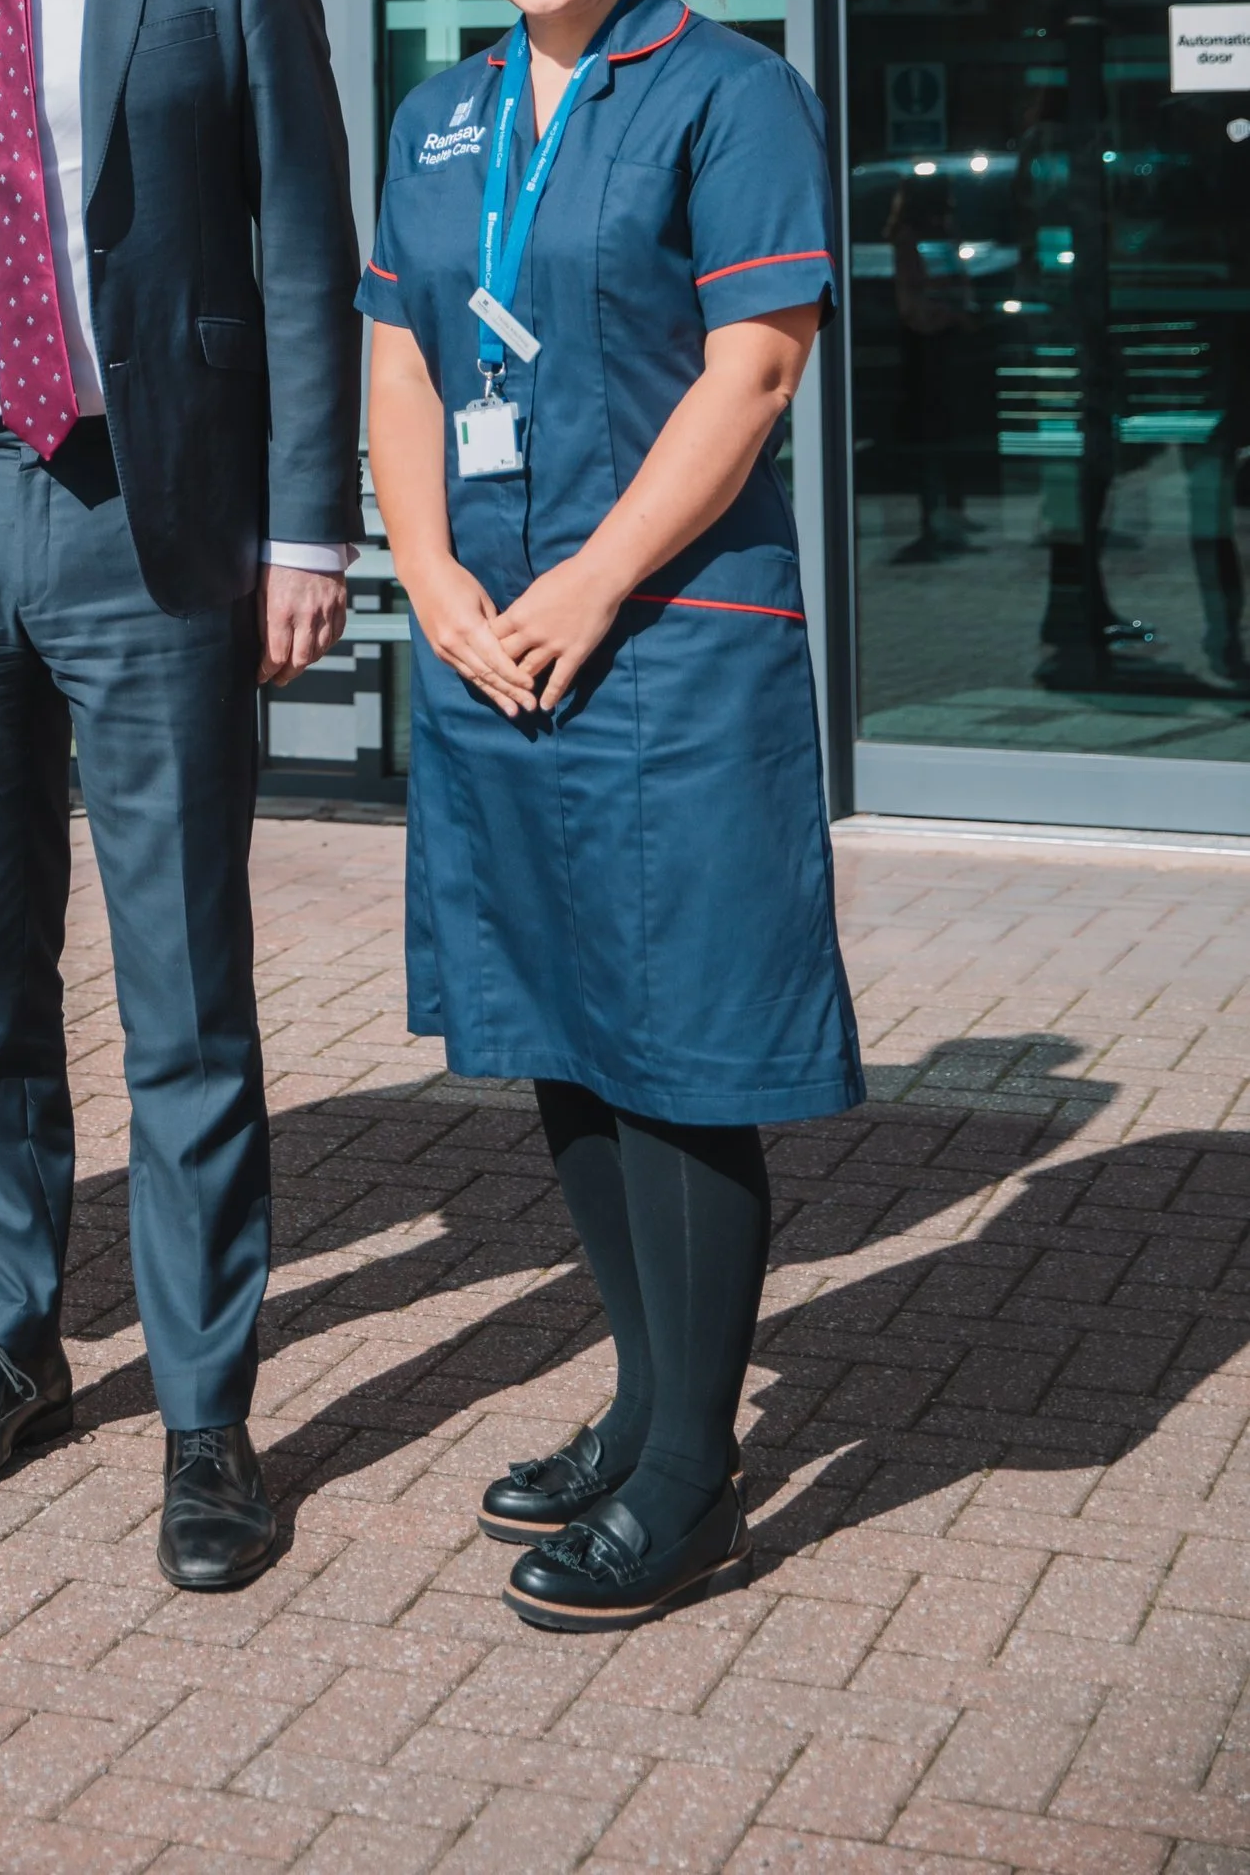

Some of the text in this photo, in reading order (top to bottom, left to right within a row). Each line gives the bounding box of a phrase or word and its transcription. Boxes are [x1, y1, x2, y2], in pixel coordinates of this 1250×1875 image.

[1197, 51, 1233, 64] door
[423, 125, 486, 150] Ramsay
[418, 142, 481, 165] Health Care
